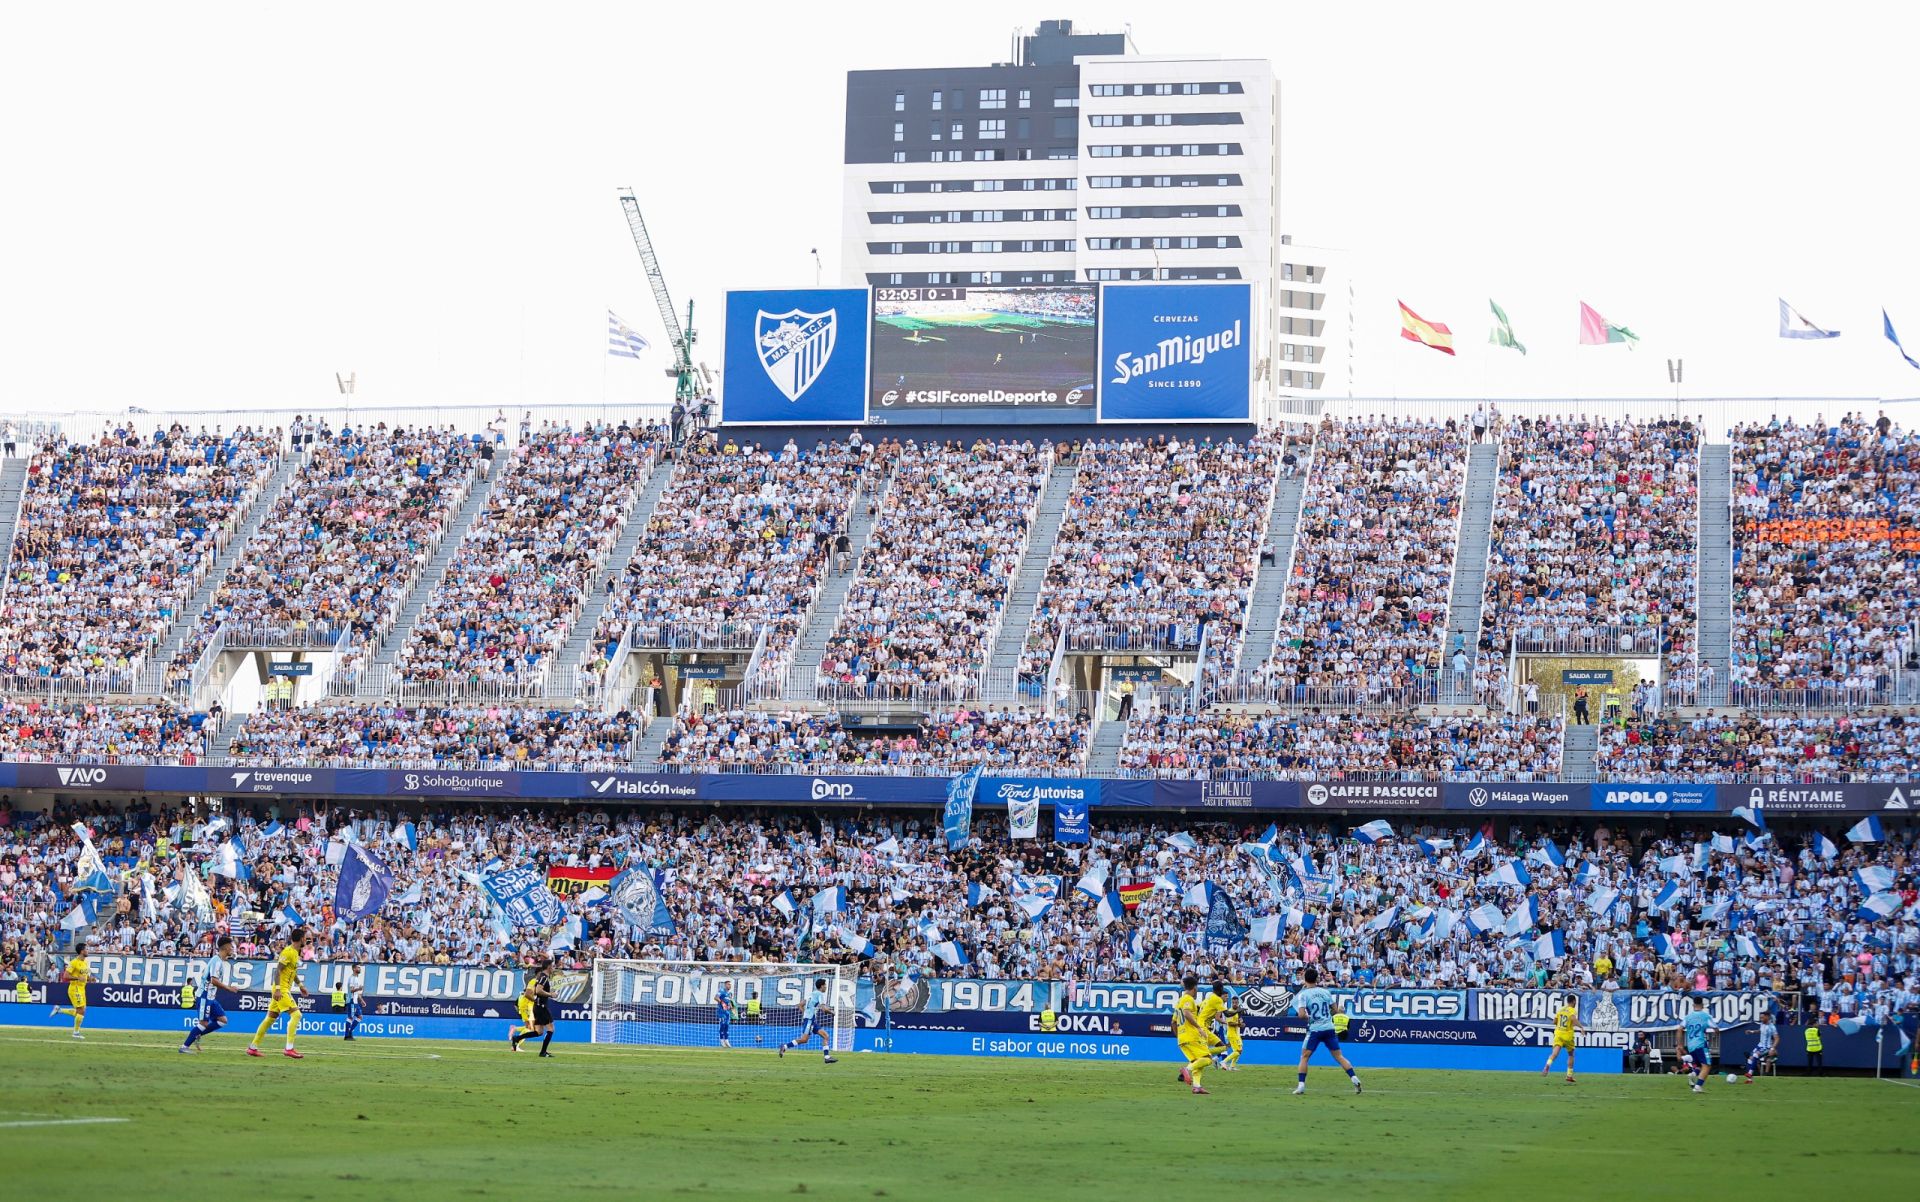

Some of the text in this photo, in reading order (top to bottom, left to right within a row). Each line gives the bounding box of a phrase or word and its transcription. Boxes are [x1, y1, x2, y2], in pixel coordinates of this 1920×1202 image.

[879, 290, 918, 300] 32:05
[928, 290, 937, 300] 0
[952, 289, 958, 300] 1
[905, 390, 1058, 405] #CSIFconelDeporte
[253, 771, 312, 784] trevenque
[616, 778, 696, 795] Halcón viajes
[997, 783, 1084, 799] Ford Autovisa
[1330, 786, 1438, 798] CAFFE PASCUCCI
[1491, 790, 1528, 803] Málaga
[1531, 791, 1569, 803] Wagen
[1605, 791, 1668, 804] APOLO
[1768, 788, 1844, 802] RÉNTAME
[487, 872, 516, 889] LOS
[376, 965, 515, 999] ESCUDO
[103, 987, 142, 1004] Sould
[941, 981, 1034, 1012] 1904
[391, 1002, 429, 1014] Pinturas
[1311, 1001, 1329, 1021] 24
[296, 1017, 324, 1031] abor
[360, 1021, 384, 1034] nos
[388, 1022, 414, 1035] une
[1029, 1014, 1109, 1032] EOKAI
[1560, 1014, 1568, 1028] 12
[1379, 1028, 1408, 1039] DOÑA
[1410, 1030, 1477, 1041] FRANCISQUITA
[1688, 1023, 1702, 1039] 22
[972, 1037, 1130, 1055] El sabor que nos une
